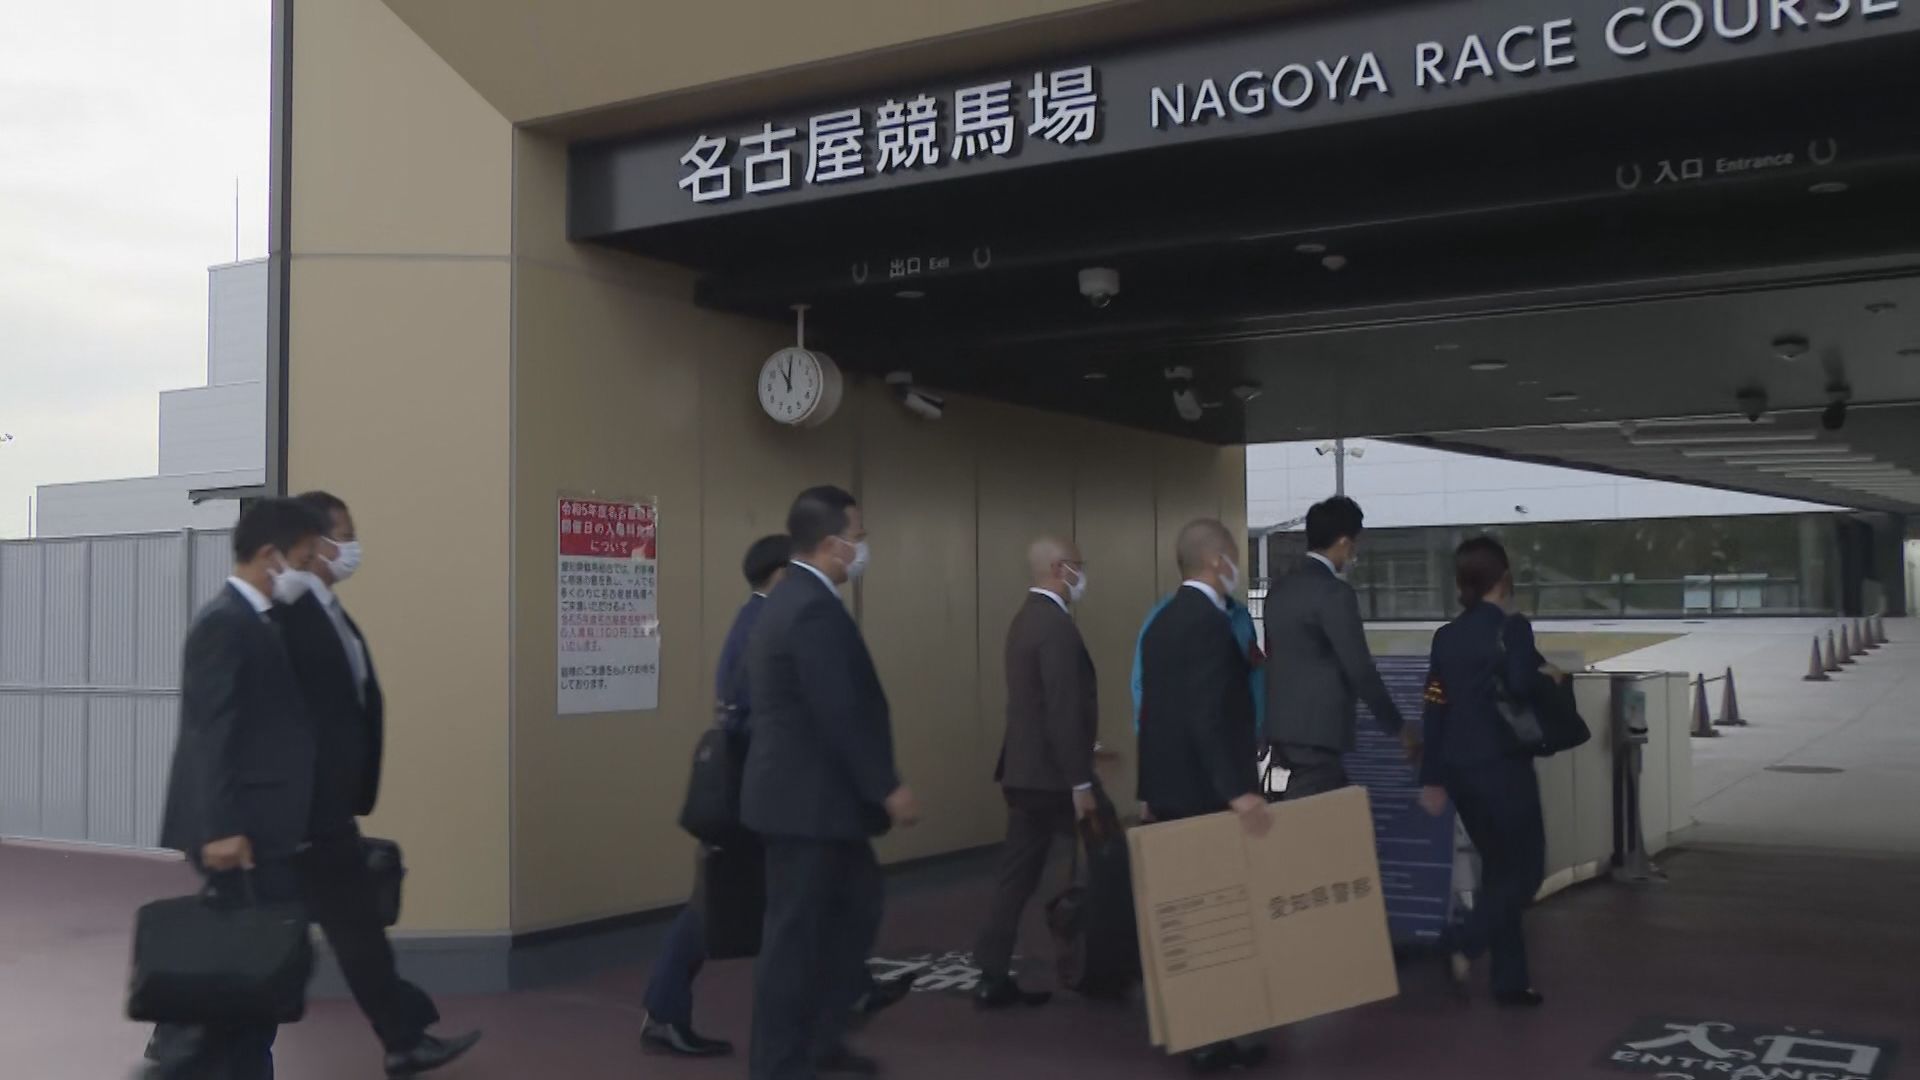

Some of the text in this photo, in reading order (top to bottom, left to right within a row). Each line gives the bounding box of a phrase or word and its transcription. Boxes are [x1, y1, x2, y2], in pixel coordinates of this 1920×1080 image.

[678, 0, 1900, 203] 名古屋競馬場 NAGOYA RACE COUR
[1654, 152, 1795, 185] 入口 Entrance
[889, 256, 921, 278] 出口
